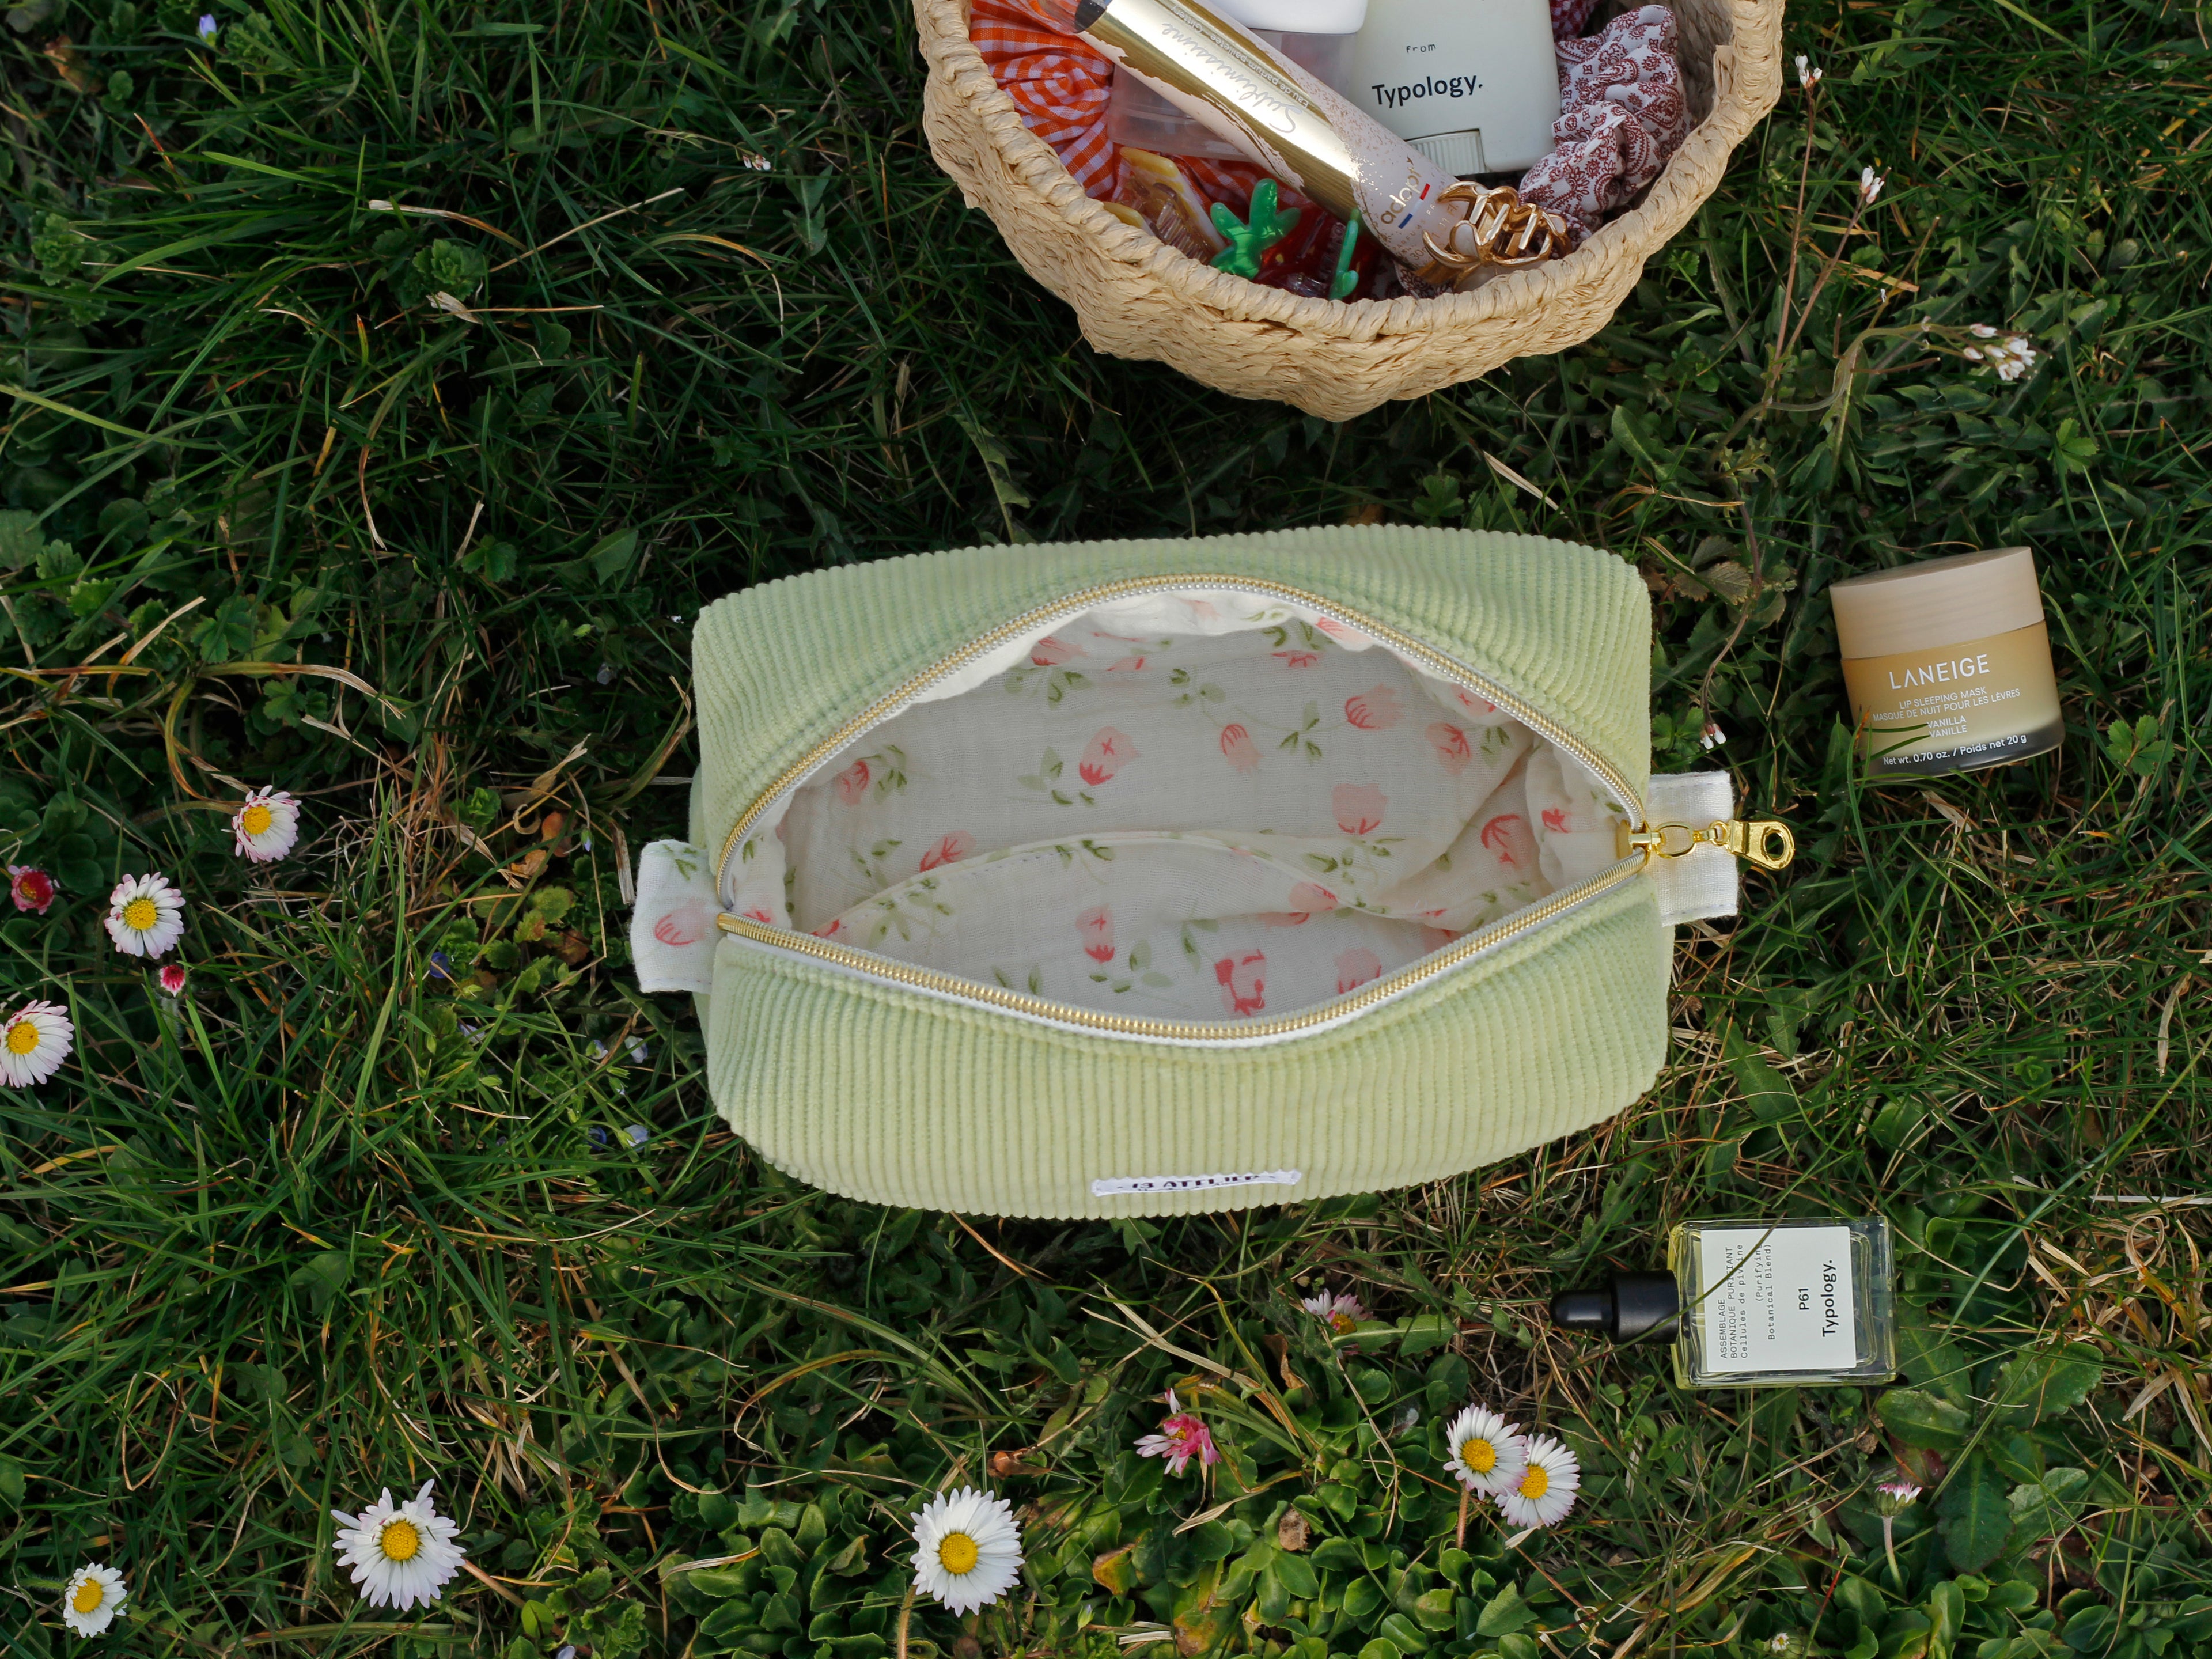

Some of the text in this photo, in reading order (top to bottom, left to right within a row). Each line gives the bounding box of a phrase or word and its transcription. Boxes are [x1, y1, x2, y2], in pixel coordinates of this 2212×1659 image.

[1171, 5, 1203, 33] Glittery
[1406, 44, 1437, 54] from
[1161, 23, 1302, 134] Sublimissime
[1248, 62, 1279, 85] parfum
[1280, 84, 1291, 95] de
[1293, 92, 1309, 109] Eau
[1372, 75, 1483, 108] Typology.
[1889, 654, 1991, 690] LANEIGE
[1873, 688, 2021, 721] MASQUE DE NUIT POUR LES LÈVRES
[1899, 687, 1987, 709] LIP SLEEPING MASK
[1926, 715, 1967, 729] VANILLA
[1929, 725, 1968, 738] VANILLE
[1883, 756, 1897, 766] Net
[1897, 756, 1911, 764] wt.
[1913, 752, 1933, 762] 0.70
[1936, 751, 1951, 760] oz.
[1960, 743, 1987, 756] Poids
[1989, 738, 2006, 749] net
[2006, 735, 2019, 745] 20
[2020, 734, 2027, 744] g
[1736, 1244, 1748, 1358] Cellules de pivine
[1763, 1244, 1775, 1340] Botanical Blend)
[1798, 1288, 1809, 1310] P61
[1820, 1260, 1839, 1337] Typology.
[1718, 1298, 1728, 1359] ASSEMBLAGE
[1728, 1306, 1738, 1358] BOTANIQUE
